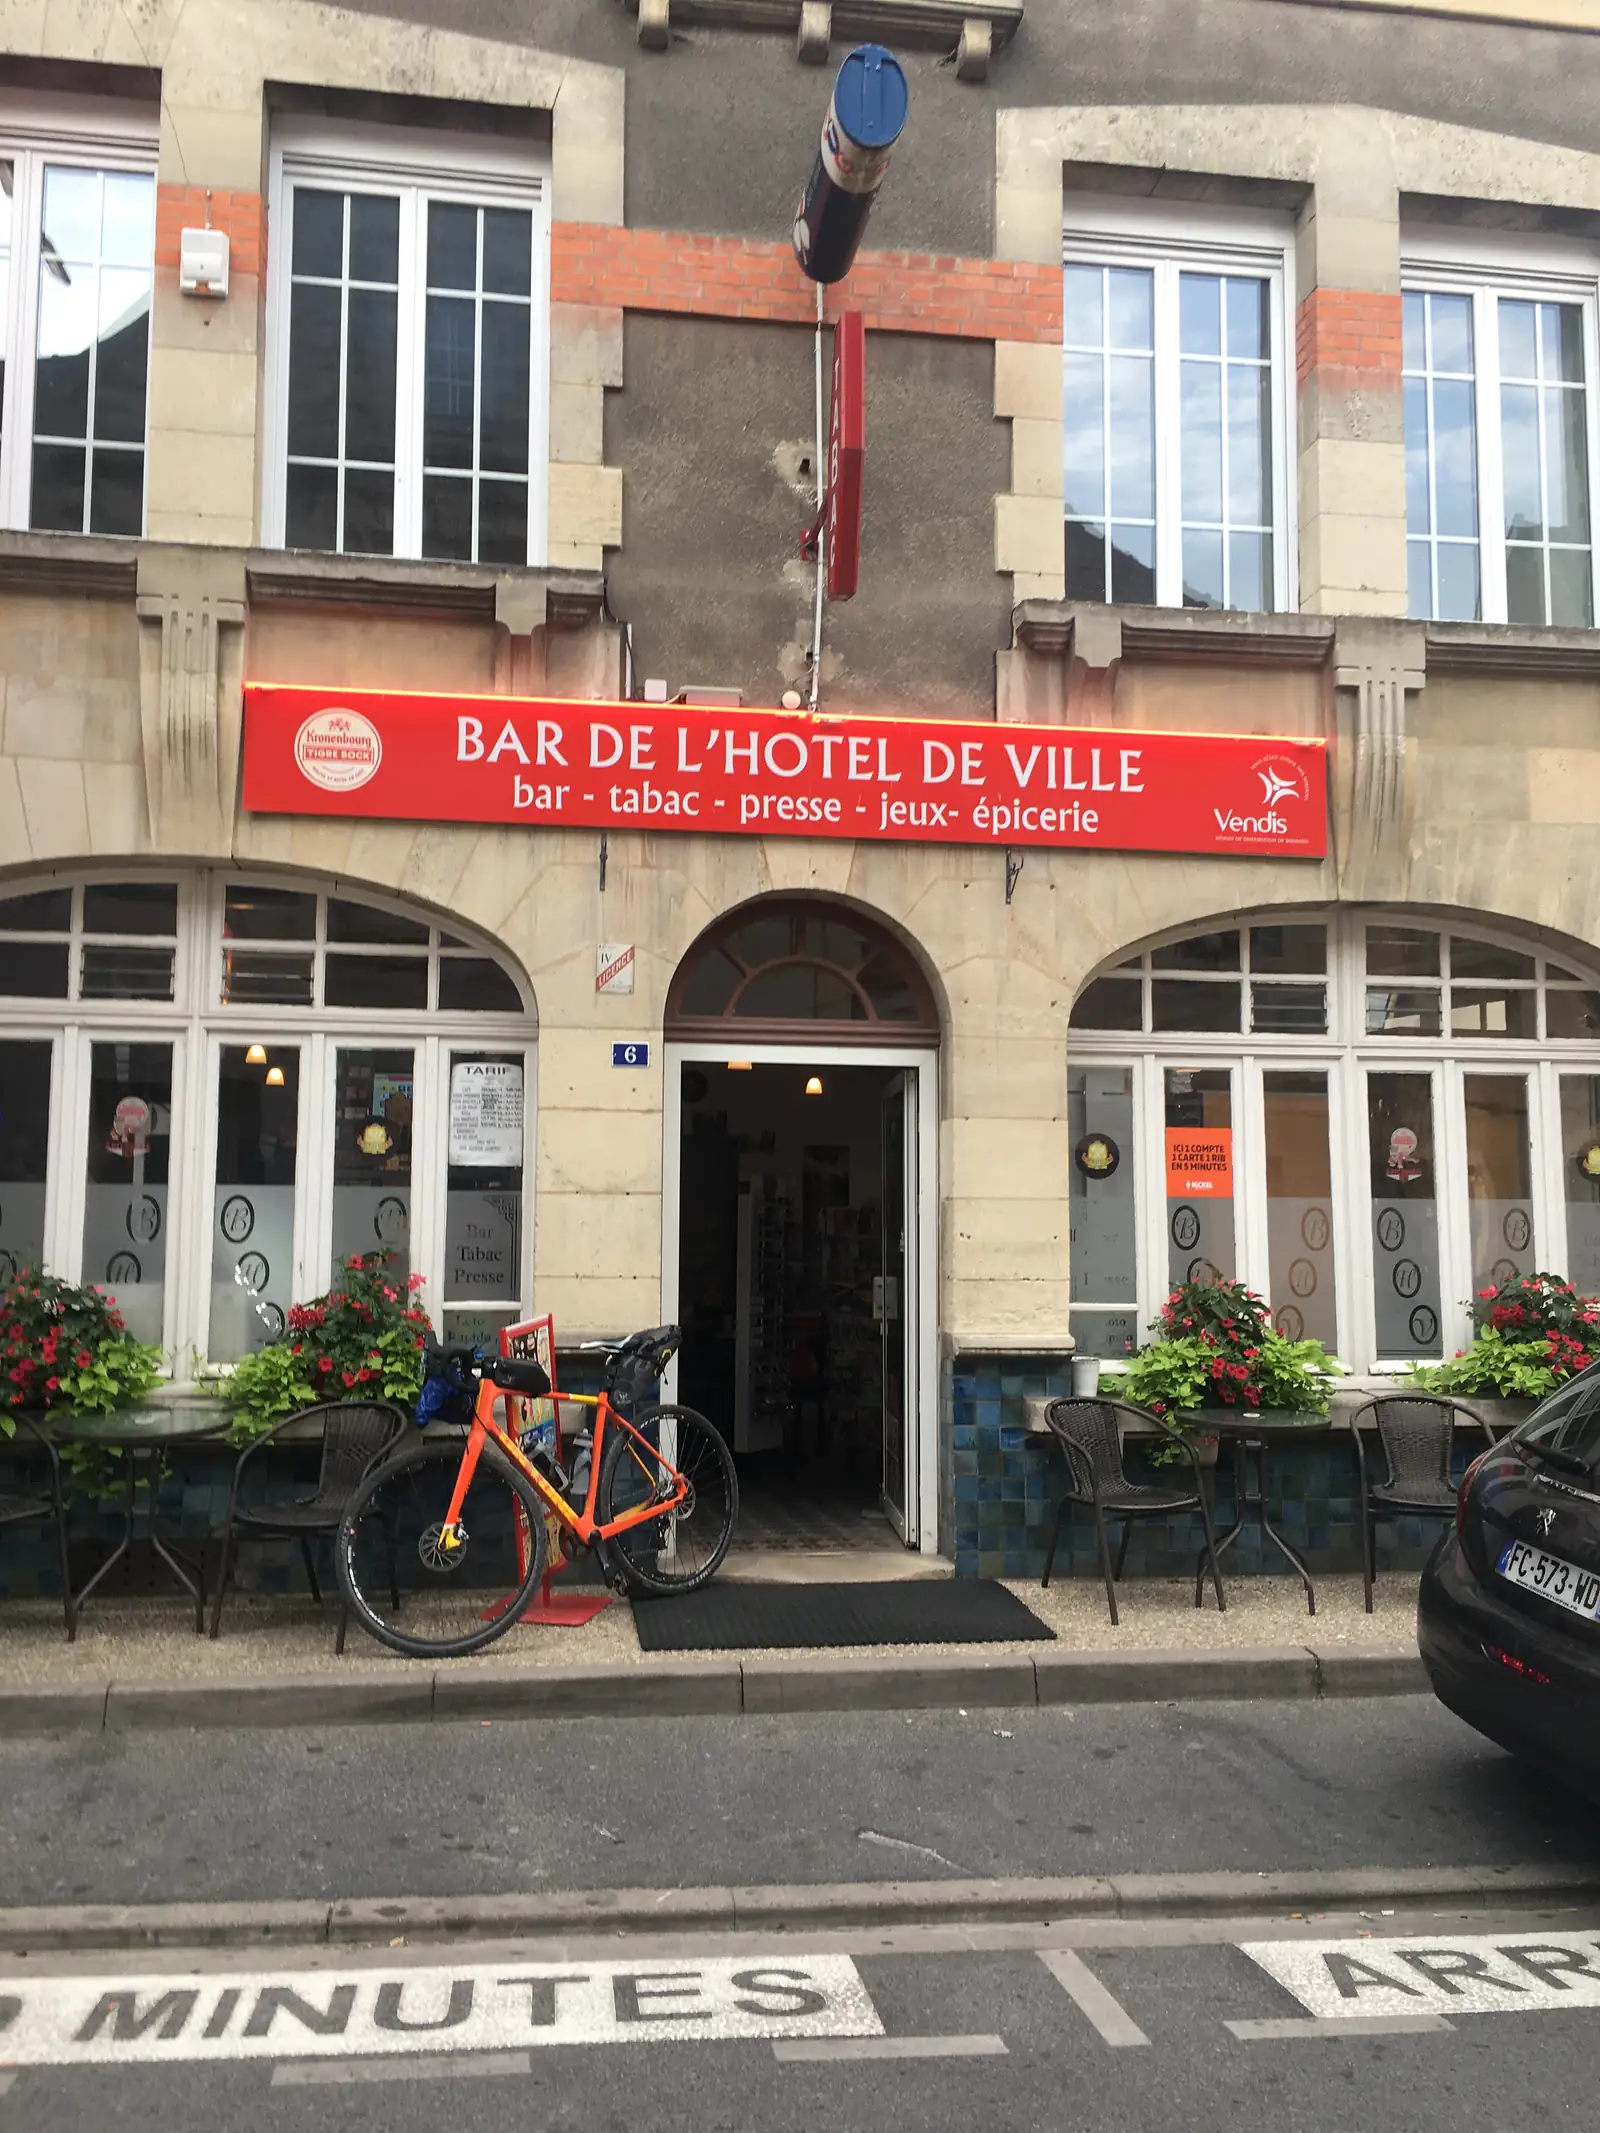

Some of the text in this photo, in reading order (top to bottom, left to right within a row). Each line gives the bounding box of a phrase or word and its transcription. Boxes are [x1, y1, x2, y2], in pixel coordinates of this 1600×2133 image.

[830, 357, 840, 568] TABAC
[306, 729, 372, 748] Kronenbourg
[456, 716, 1145, 793] BAR DE L'HOTEL DE VILLE
[513, 774, 570, 811] bar
[609, 780, 700, 816] tabac
[740, 794, 842, 826] presse
[973, 796, 1099, 835] épicerie
[1213, 808, 1288, 834] Vendis
[598, 949, 633, 987] LICENCE
[624, 1045, 637, 1064] 6
[464, 1066, 511, 1075] TARIF
[1173, 1144, 1184, 1152] ICI
[1191, 1144, 1225, 1153] COMPTE
[1178, 1153, 1205, 1162] CARTE
[1212, 1154, 1226, 1162] RIB
[1171, 1162, 1182, 1170] EN
[1190, 1163, 1227, 1171] MINUTES
[456, 1245, 503, 1262] Tabac
[454, 1269, 505, 1284] Presse
[1508, 1543, 1600, 1610] FC-573-WD
[1321, 1941, 1600, 1998] ARR
[72, 1968, 827, 2043] MINUTES
